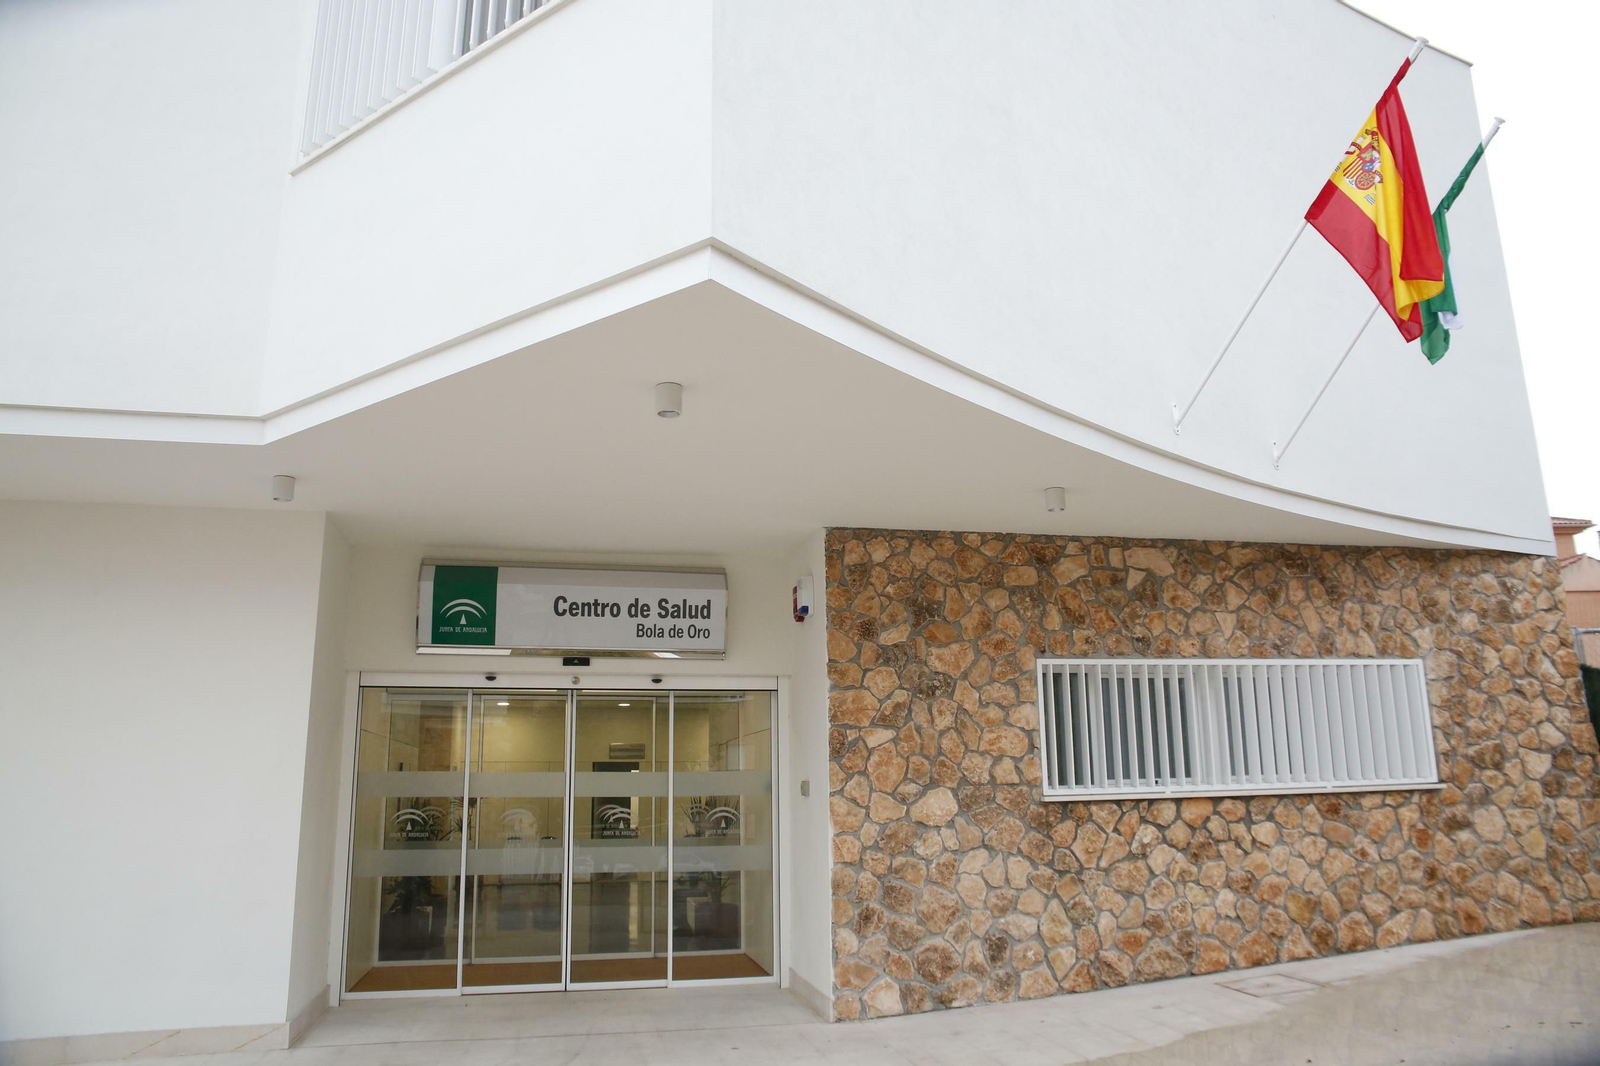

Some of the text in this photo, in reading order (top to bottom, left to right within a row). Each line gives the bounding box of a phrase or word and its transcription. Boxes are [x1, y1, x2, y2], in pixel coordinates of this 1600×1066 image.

[553, 595, 712, 620] Centro de Salud
[636, 623, 711, 639] Bola de Oro
